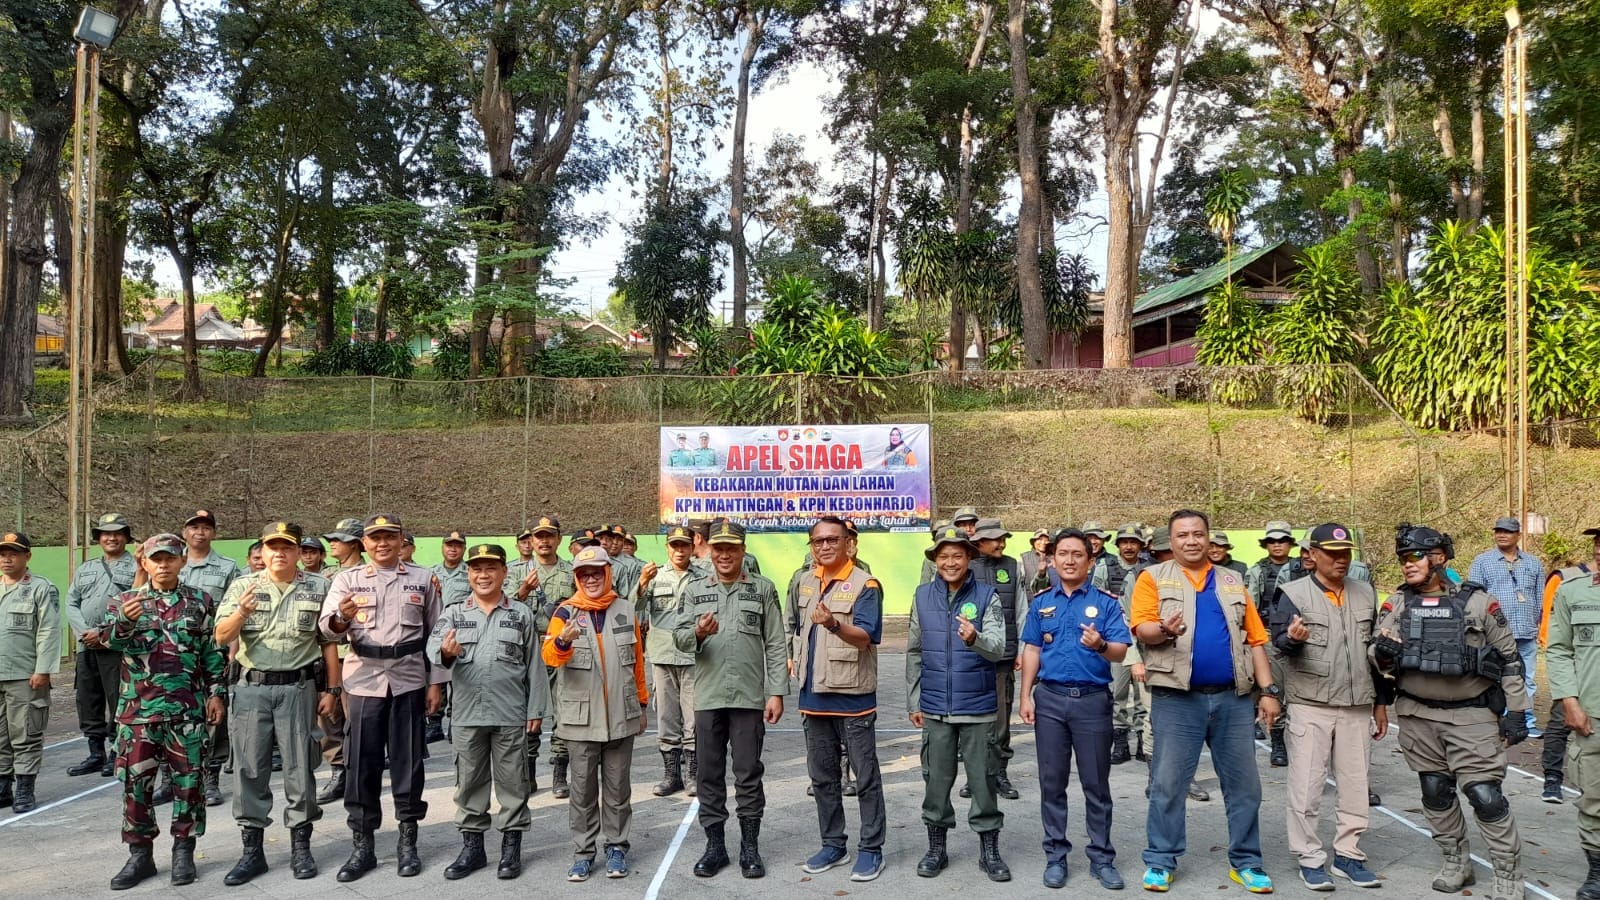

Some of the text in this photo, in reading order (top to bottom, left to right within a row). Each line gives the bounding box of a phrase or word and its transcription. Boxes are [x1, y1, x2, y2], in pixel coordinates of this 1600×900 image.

[726, 444, 863, 471] APEL SIAGA
[694, 476, 895, 492] KEBAKARAN HUTAN DAN LAHAN
[675, 496, 915, 512] KPH MANTINGAN & KPH KEBONHARJO
[749, 518, 778, 530] Cegah
[780, 518, 820, 526] Kebaka
[880, 515, 910, 528] Lahan
